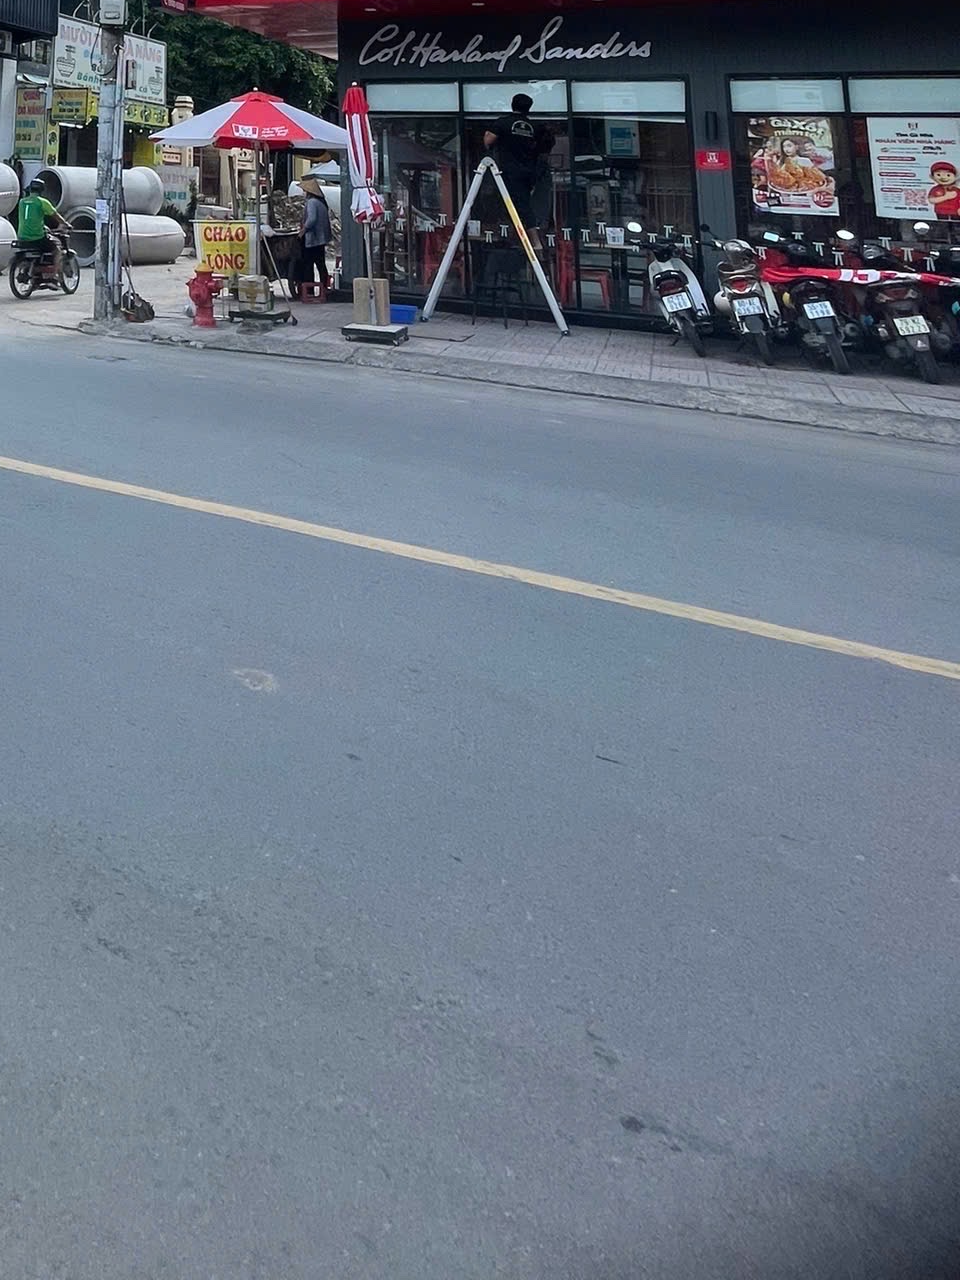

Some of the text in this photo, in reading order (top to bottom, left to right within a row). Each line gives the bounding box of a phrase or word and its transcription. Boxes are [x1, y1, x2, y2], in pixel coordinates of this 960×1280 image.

[519, 16, 652, 64] Sanders
[203, 223, 247, 243] CHÁO
[206, 249, 246, 270] LÒNG
